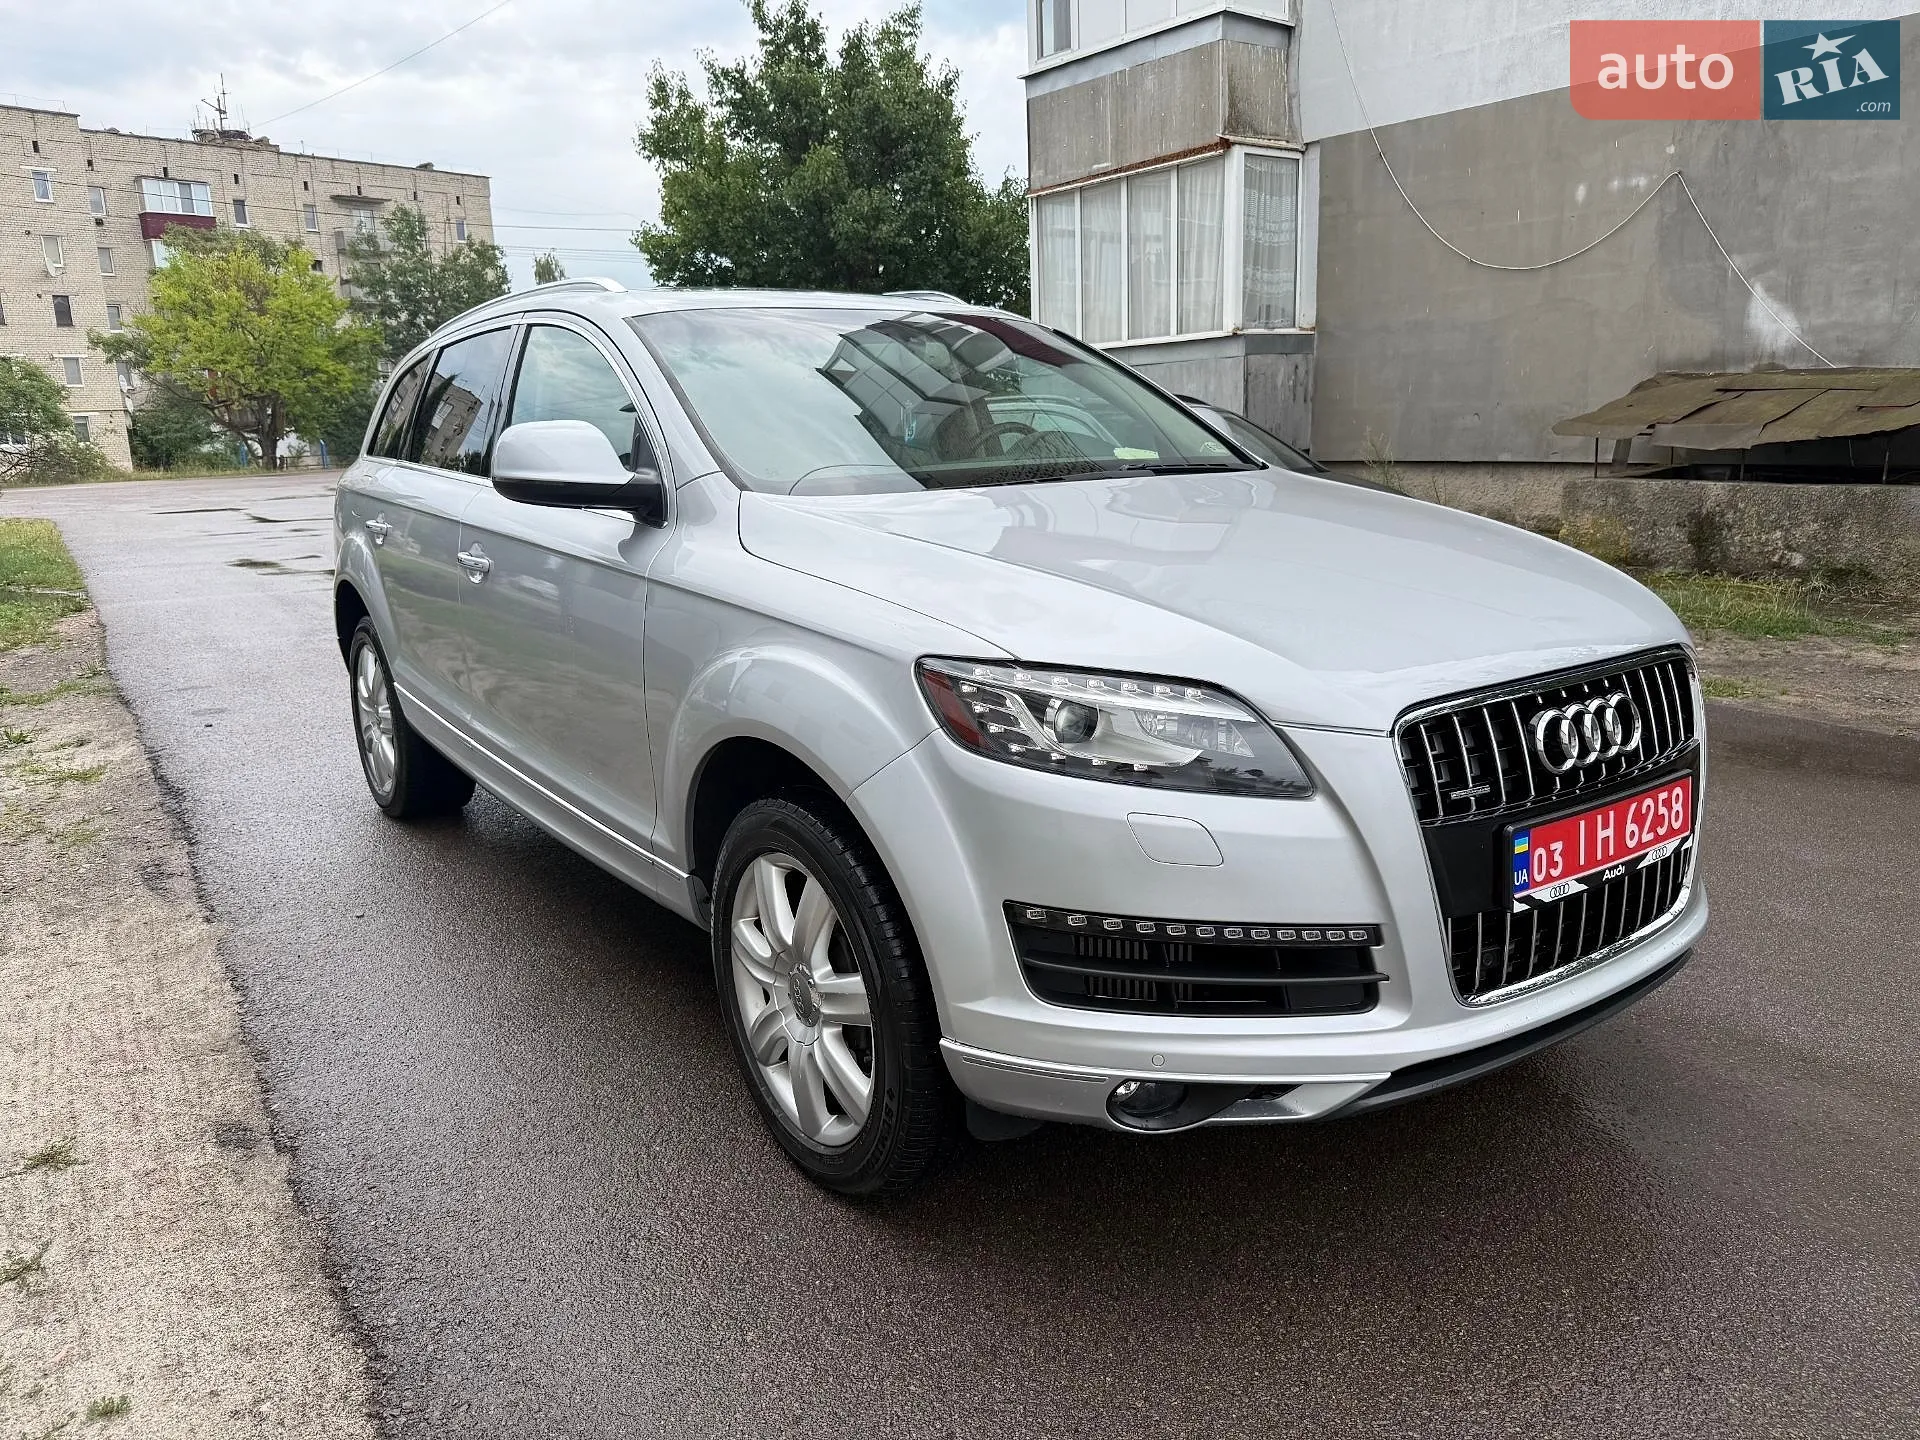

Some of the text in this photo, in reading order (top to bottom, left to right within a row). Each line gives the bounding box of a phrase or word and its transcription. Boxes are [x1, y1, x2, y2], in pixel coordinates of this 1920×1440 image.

[1533, 840, 1563, 882] 03
[1625, 786, 1684, 849] 6258
[1514, 869, 1529, 886] UA
[1602, 864, 1626, 882] Audi
